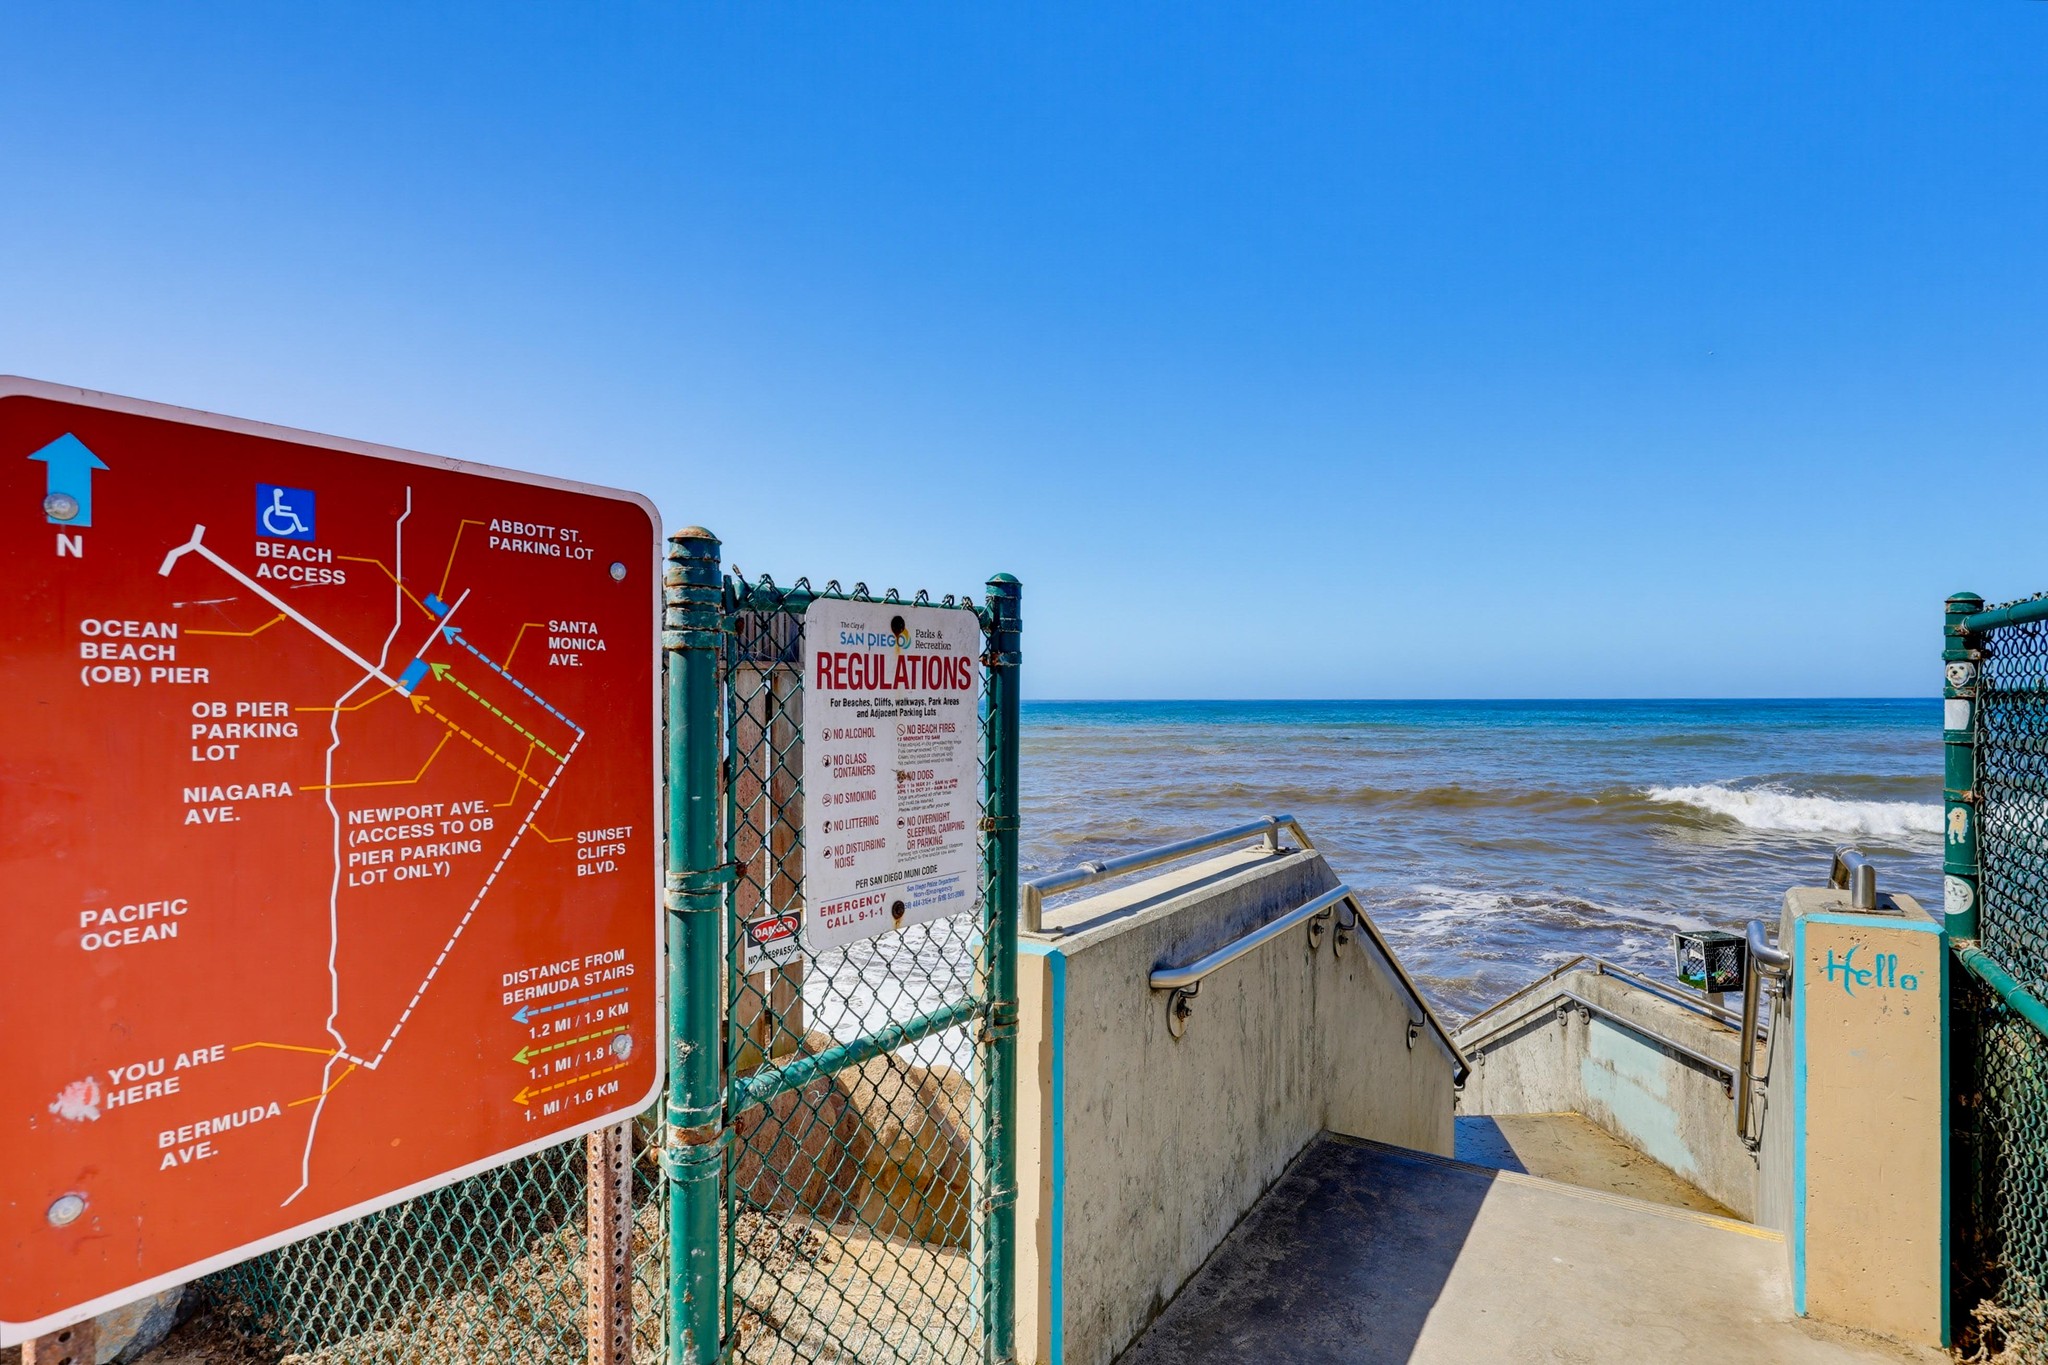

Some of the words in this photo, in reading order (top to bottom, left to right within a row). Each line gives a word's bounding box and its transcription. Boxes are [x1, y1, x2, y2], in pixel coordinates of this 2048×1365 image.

[490, 519, 555, 538] ABBOTT
[561, 529, 582, 542] ST.
[58, 534, 82, 557] N
[256, 542, 331, 563] BEACH
[490, 537, 560, 556] PARKING
[567, 546, 593, 560] LOT
[257, 564, 345, 585] ACCESS
[81, 619, 177, 638] OCEAN
[549, 621, 597, 634] SANTA
[915, 629, 936, 639] Parks
[937, 631, 943, 639] &
[549, 637, 605, 650] MONICA
[840, 632, 864, 645] SAN
[868, 634, 906, 648] DIEGO
[915, 640, 951, 650] Recreation
[81, 643, 174, 660] BEACH
[550, 654, 583, 667] AVE.
[81, 666, 141, 686] (OB)
[151, 667, 208, 683] PIER
[817, 652, 971, 690] REGULATIONS
[192, 702, 227, 717] OB
[237, 702, 288, 717] PIER
[830, 698, 841, 707] For
[874, 698, 894, 708] Cliffs,
[895, 698, 926, 708] walkways,
[928, 697, 941, 706] Park
[943, 697, 959, 706] Areas
[857, 709, 869, 718] and
[870, 709, 898, 719] Adjacent
[900, 708, 923, 718] Parking
[192, 723, 297, 739] PARKING
[833, 728, 843, 739] NO
[845, 727, 876, 739] ALCOHOL
[906, 724, 916, 735] NO
[917, 723, 938, 734] BEACH
[939, 723, 956, 733] FIRES
[192, 745, 239, 761] LOT
[833, 754, 843, 766] NO
[845, 753, 867, 765] GLASS
[833, 765, 876, 778] CONTAINERS
[907, 771, 916, 781] NO
[917, 769, 934, 780] DOGS
[184, 782, 292, 803] NIAGARA
[833, 793, 843, 805] NO
[845, 790, 876, 803] SMOKING
[185, 807, 240, 825] AVE.
[349, 804, 443, 824] NEWPORT
[450, 801, 488, 815] AVE.
[907, 816, 916, 826] NO
[917, 811, 950, 825] OVERNIGHT
[349, 823, 435, 846] (ACCESS
[440, 821, 463, 834] TO
[470, 818, 493, 831] OB
[834, 820, 843, 831] NO
[845, 815, 879, 830] LITTERING
[907, 827, 937, 838] SLEEPING,
[938, 821, 965, 834] CAMPING
[578, 827, 632, 843] SUNSET
[907, 840, 916, 851] OR
[917, 835, 943, 849] PARKING
[349, 849, 393, 867] PIER
[401, 840, 481, 860] PARKING
[578, 843, 625, 859] CLIFFS
[834, 845, 844, 857] NO
[846, 838, 886, 854] DISTURBING
[578, 861, 617, 876] BLVD.
[834, 855, 855, 869] NOISE
[349, 869, 387, 886] LOT
[394, 862, 450, 880] ONLY)
[855, 878, 869, 889] PER
[869, 875, 883, 886] SAN
[884, 871, 903, 884] DIEGO
[904, 867, 921, 879] MUNI
[921, 865, 938, 876] CODE
[80, 899, 187, 928] PACIFIC
[820, 893, 887, 918] EMERGENCY
[826, 914, 854, 929] CALL
[858, 906, 883, 921] 9-1-1
[81, 922, 177, 951] OCEAN
[503, 959, 580, 986] DISTANCE
[585, 949, 624, 967] FROM
[748, 955, 758, 965] NO
[1822, 944, 1918, 998] Hello
[503, 977, 579, 1006] BERMUDA
[585, 964, 634, 985] STAIRS
[530, 1024, 549, 1038] 1.2
[555, 1018, 570, 1032] MI
[585, 1010, 603, 1023] 1.9
[609, 1002, 628, 1017] KM
[108, 1058, 166, 1086] YOU
[174, 1045, 224, 1070] ARE
[530, 1064, 548, 1079] 1.1
[556, 1057, 571, 1072] MI
[586, 1048, 604, 1062] 1.8
[107, 1077, 179, 1109] HERE
[544, 1100, 559, 1115] MI
[574, 1089, 593, 1104] 1.6
[598, 1081, 618, 1097] KM
[159, 1102, 281, 1148] BERMUDA
[160, 1141, 218, 1170] AVE.
